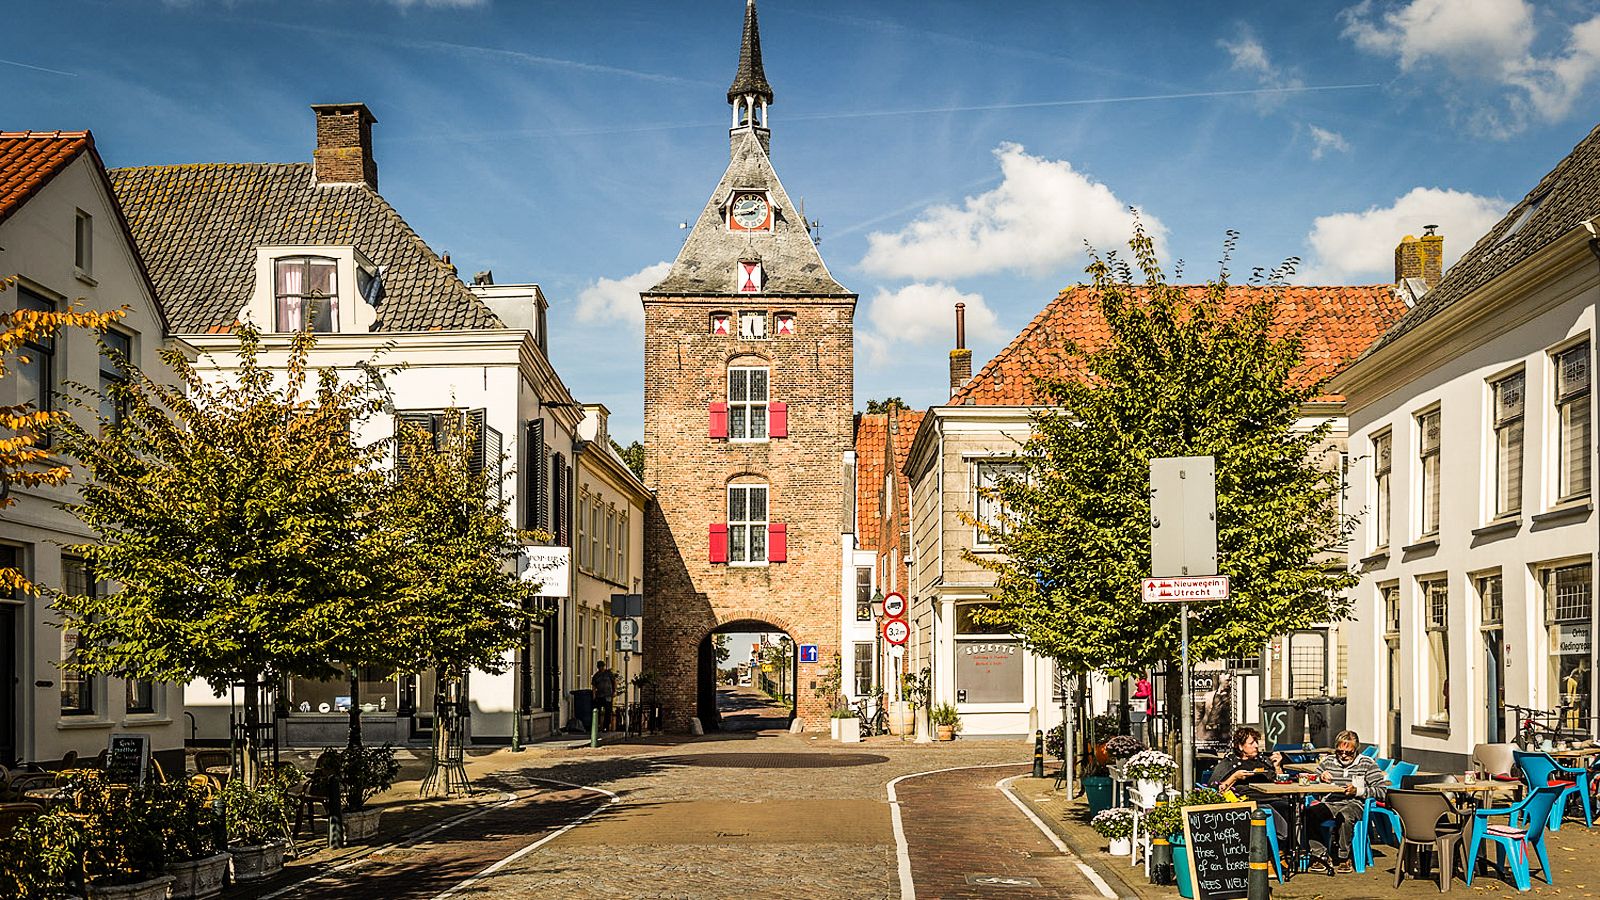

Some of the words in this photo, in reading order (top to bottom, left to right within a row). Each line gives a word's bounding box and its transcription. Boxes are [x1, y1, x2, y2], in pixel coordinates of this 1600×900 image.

[1173, 580, 1220, 588] Nieuwegein
[1173, 589, 1211, 597] Utrecht
[965, 643, 1015, 655] SUZETTE
[1559, 641, 1593, 653] Kledingrepa
[1225, 811, 1251, 825] open
[1222, 843, 1250, 857] lunch
[1198, 859, 1208, 877] of
